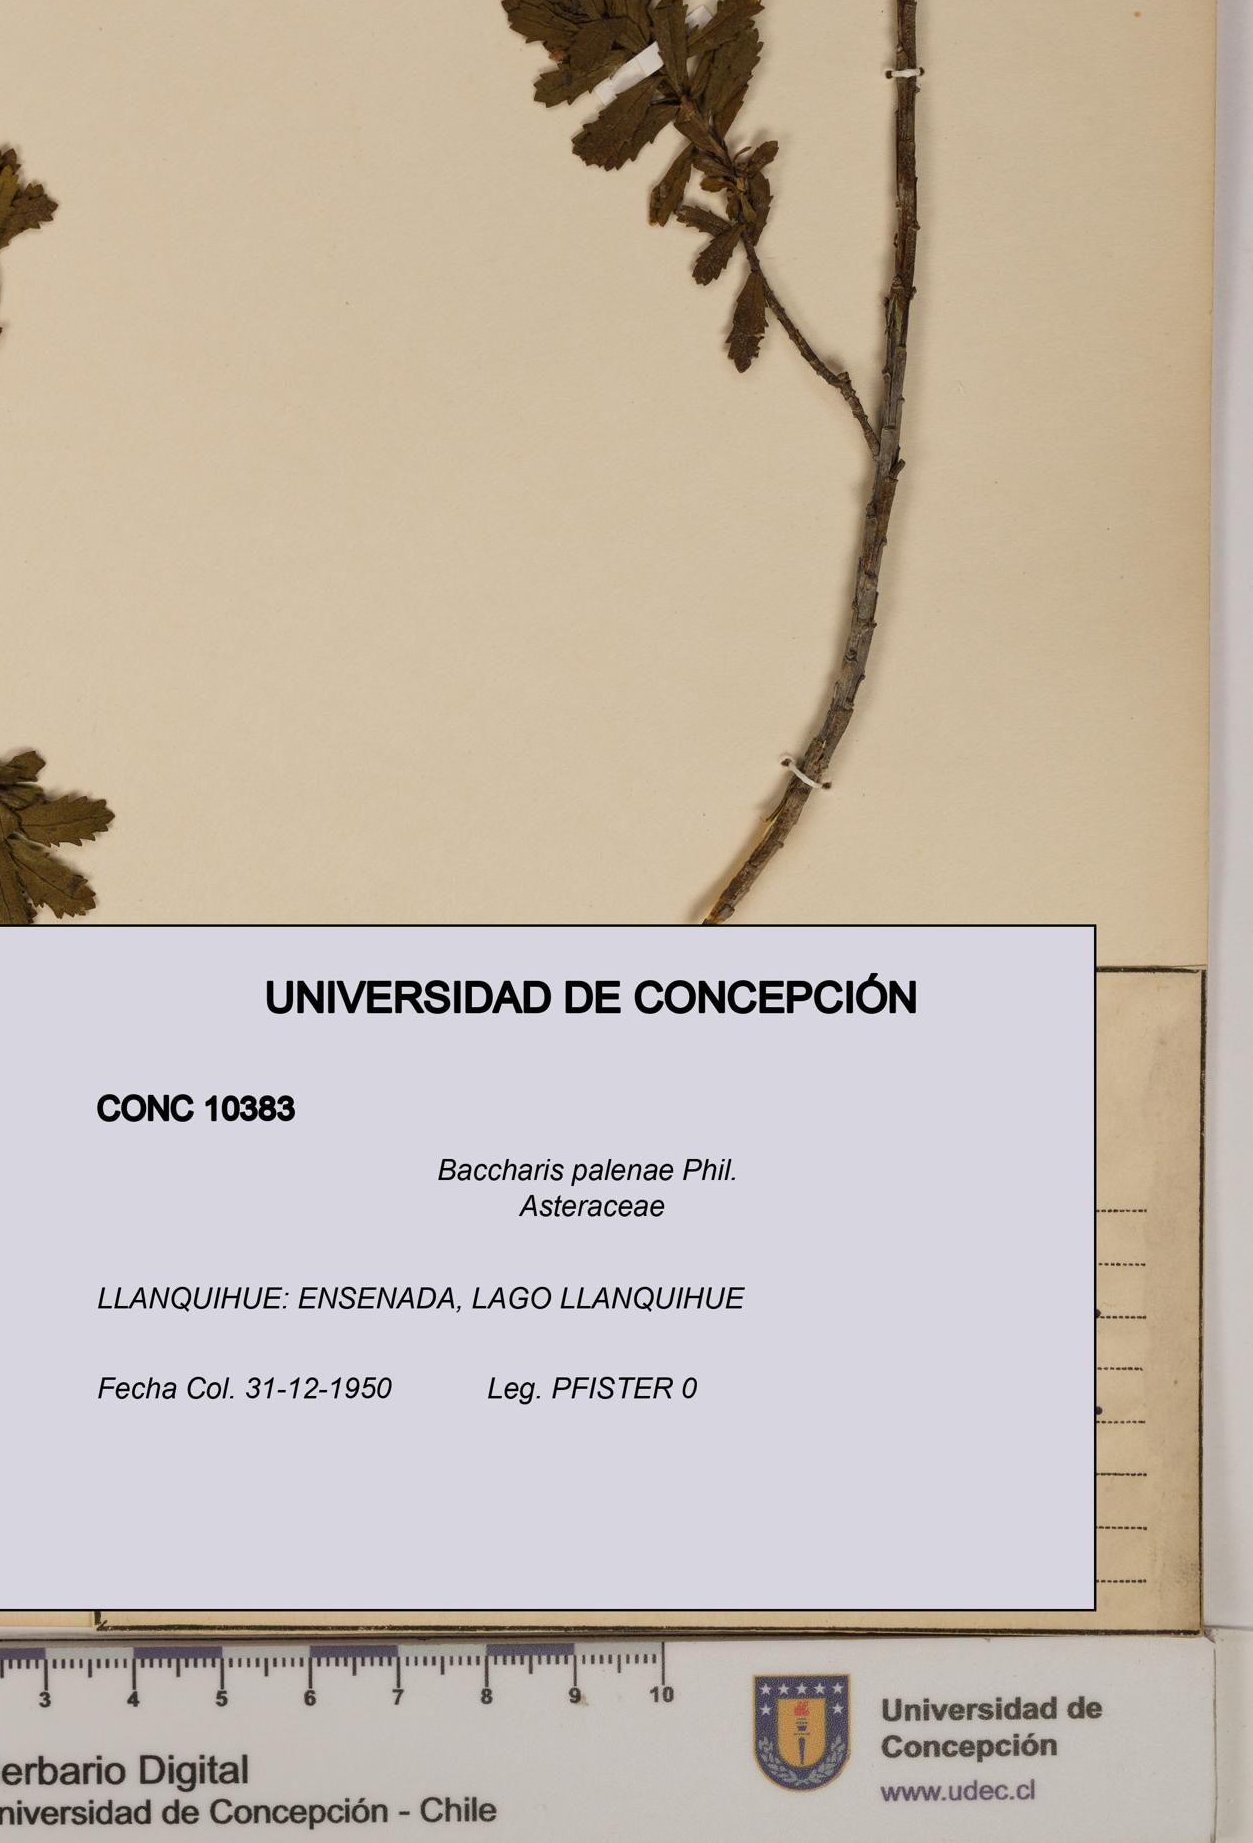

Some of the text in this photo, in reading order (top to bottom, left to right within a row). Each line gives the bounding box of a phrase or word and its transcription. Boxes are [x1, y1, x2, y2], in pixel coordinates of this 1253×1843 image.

[38, 1691, 52, 1709] 3
[126, 1690, 141, 1708] 4
[215, 1689, 229, 1708] 5
[303, 1689, 317, 1707] 6
[391, 1688, 405, 1706] 7
[480, 1687, 494, 1705] 8
[568, 1686, 582, 1705] 9
[649, 1685, 675, 1703] 10
[882, 1695, 1103, 1722] Universidad de
[881, 1732, 1058, 1763] Concepción
[139, 1753, 249, 1793] Digital
[880, 1778, 1036, 1802] www.udec.cl
[161, 1798, 200, 1826] de
[209, 1797, 388, 1830] Concepción
[420, 1796, 497, 1823] Chile
